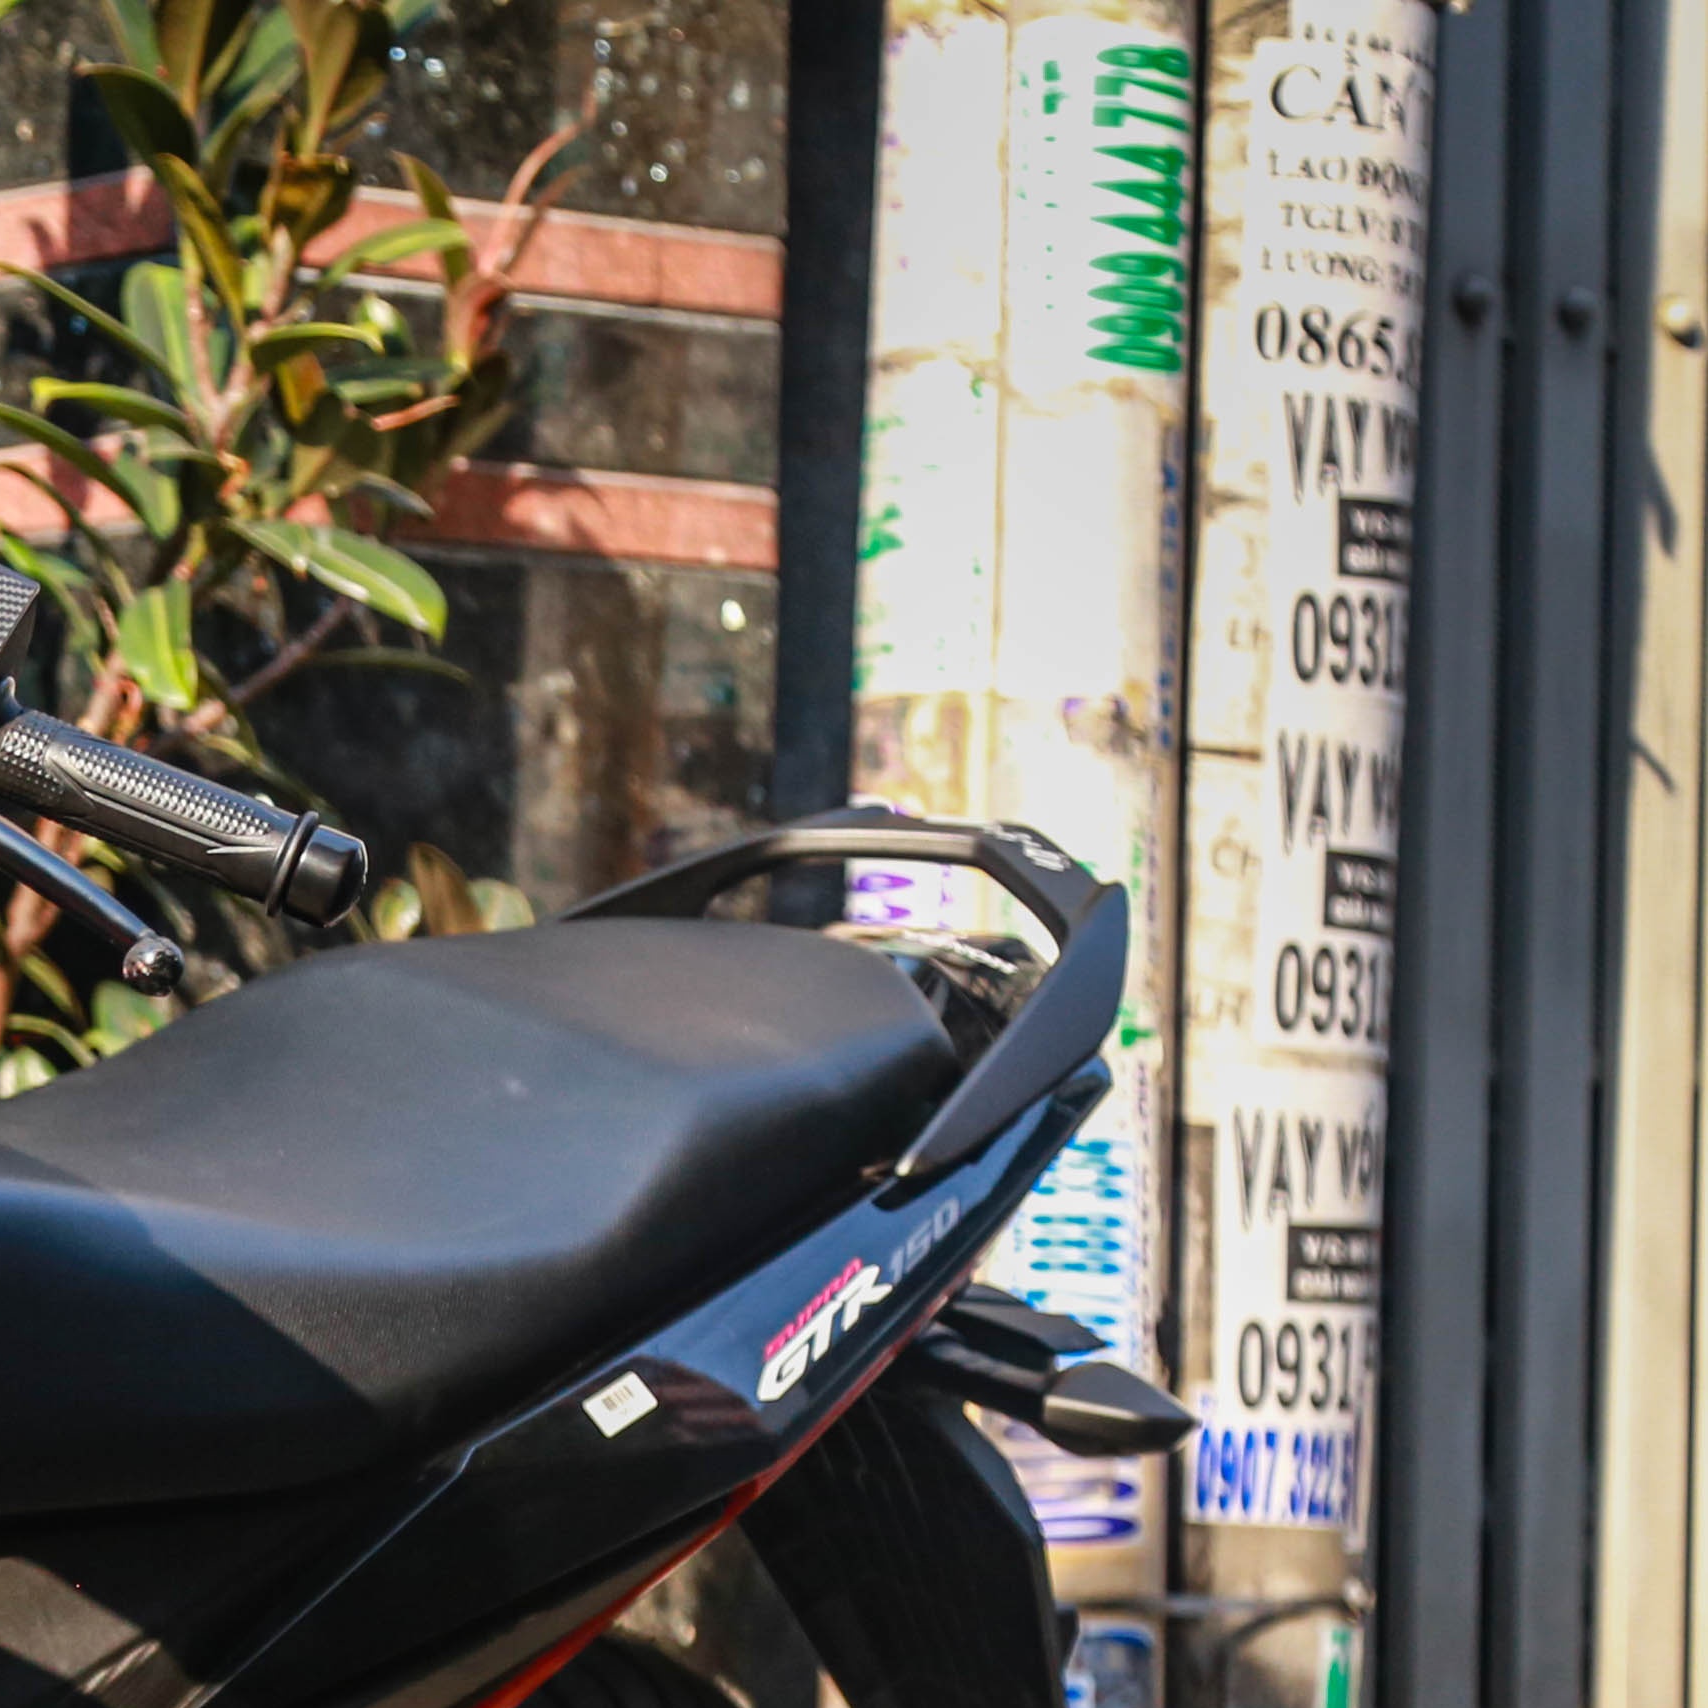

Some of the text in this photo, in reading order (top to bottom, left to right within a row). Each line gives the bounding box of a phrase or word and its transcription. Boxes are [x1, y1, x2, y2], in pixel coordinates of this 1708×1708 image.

[1087, 44, 1191, 373] 0909 444 778
[1284, 392, 1368, 503] VAY
[1277, 729, 1359, 855] VAY
[1234, 1106, 1322, 1232] VAY
[756, 1264, 894, 1402] GTR
[888, 1197, 961, 1285] 150
